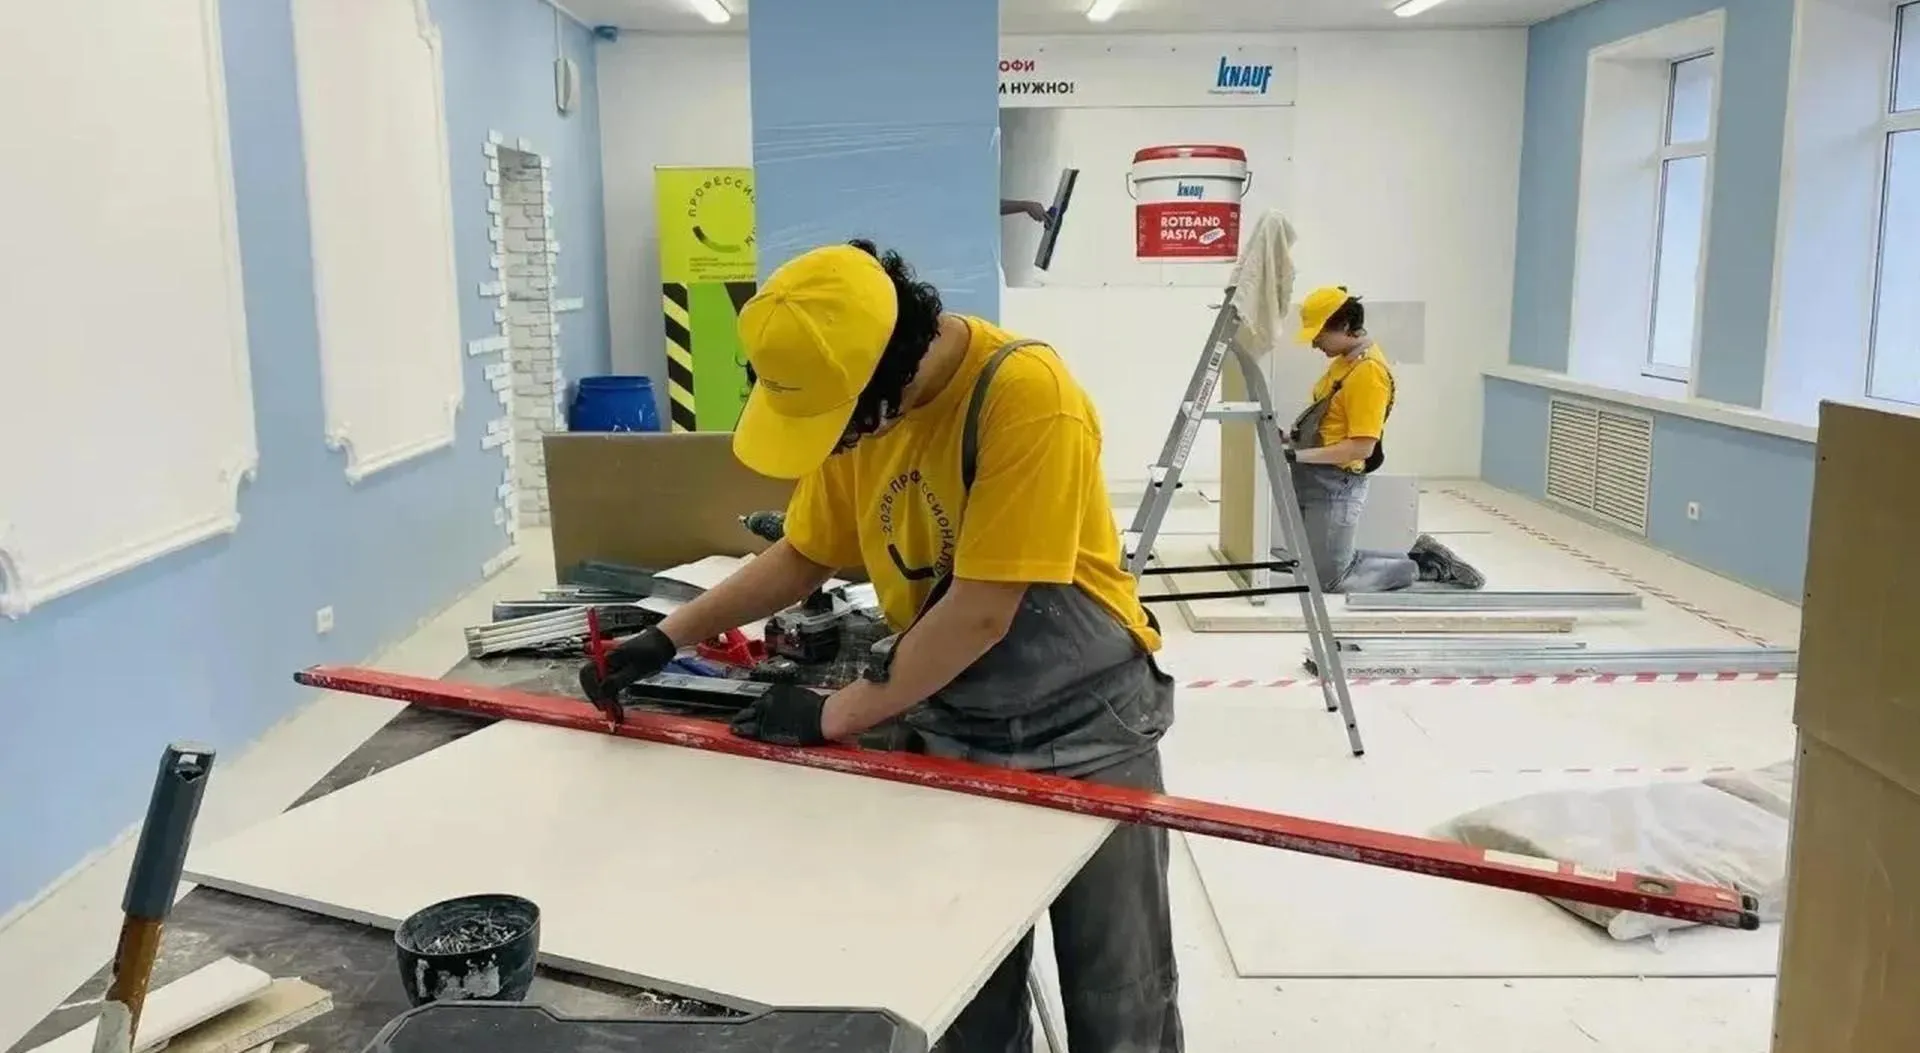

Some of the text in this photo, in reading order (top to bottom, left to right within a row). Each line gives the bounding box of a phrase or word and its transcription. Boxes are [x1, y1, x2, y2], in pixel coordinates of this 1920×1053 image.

[1011, 82, 1074, 94] НУЖНО!
[1160, 216, 1220, 228] ROTBAND
[1160, 230, 1198, 241] PASTA
[880, 493, 893, 533] 2026
